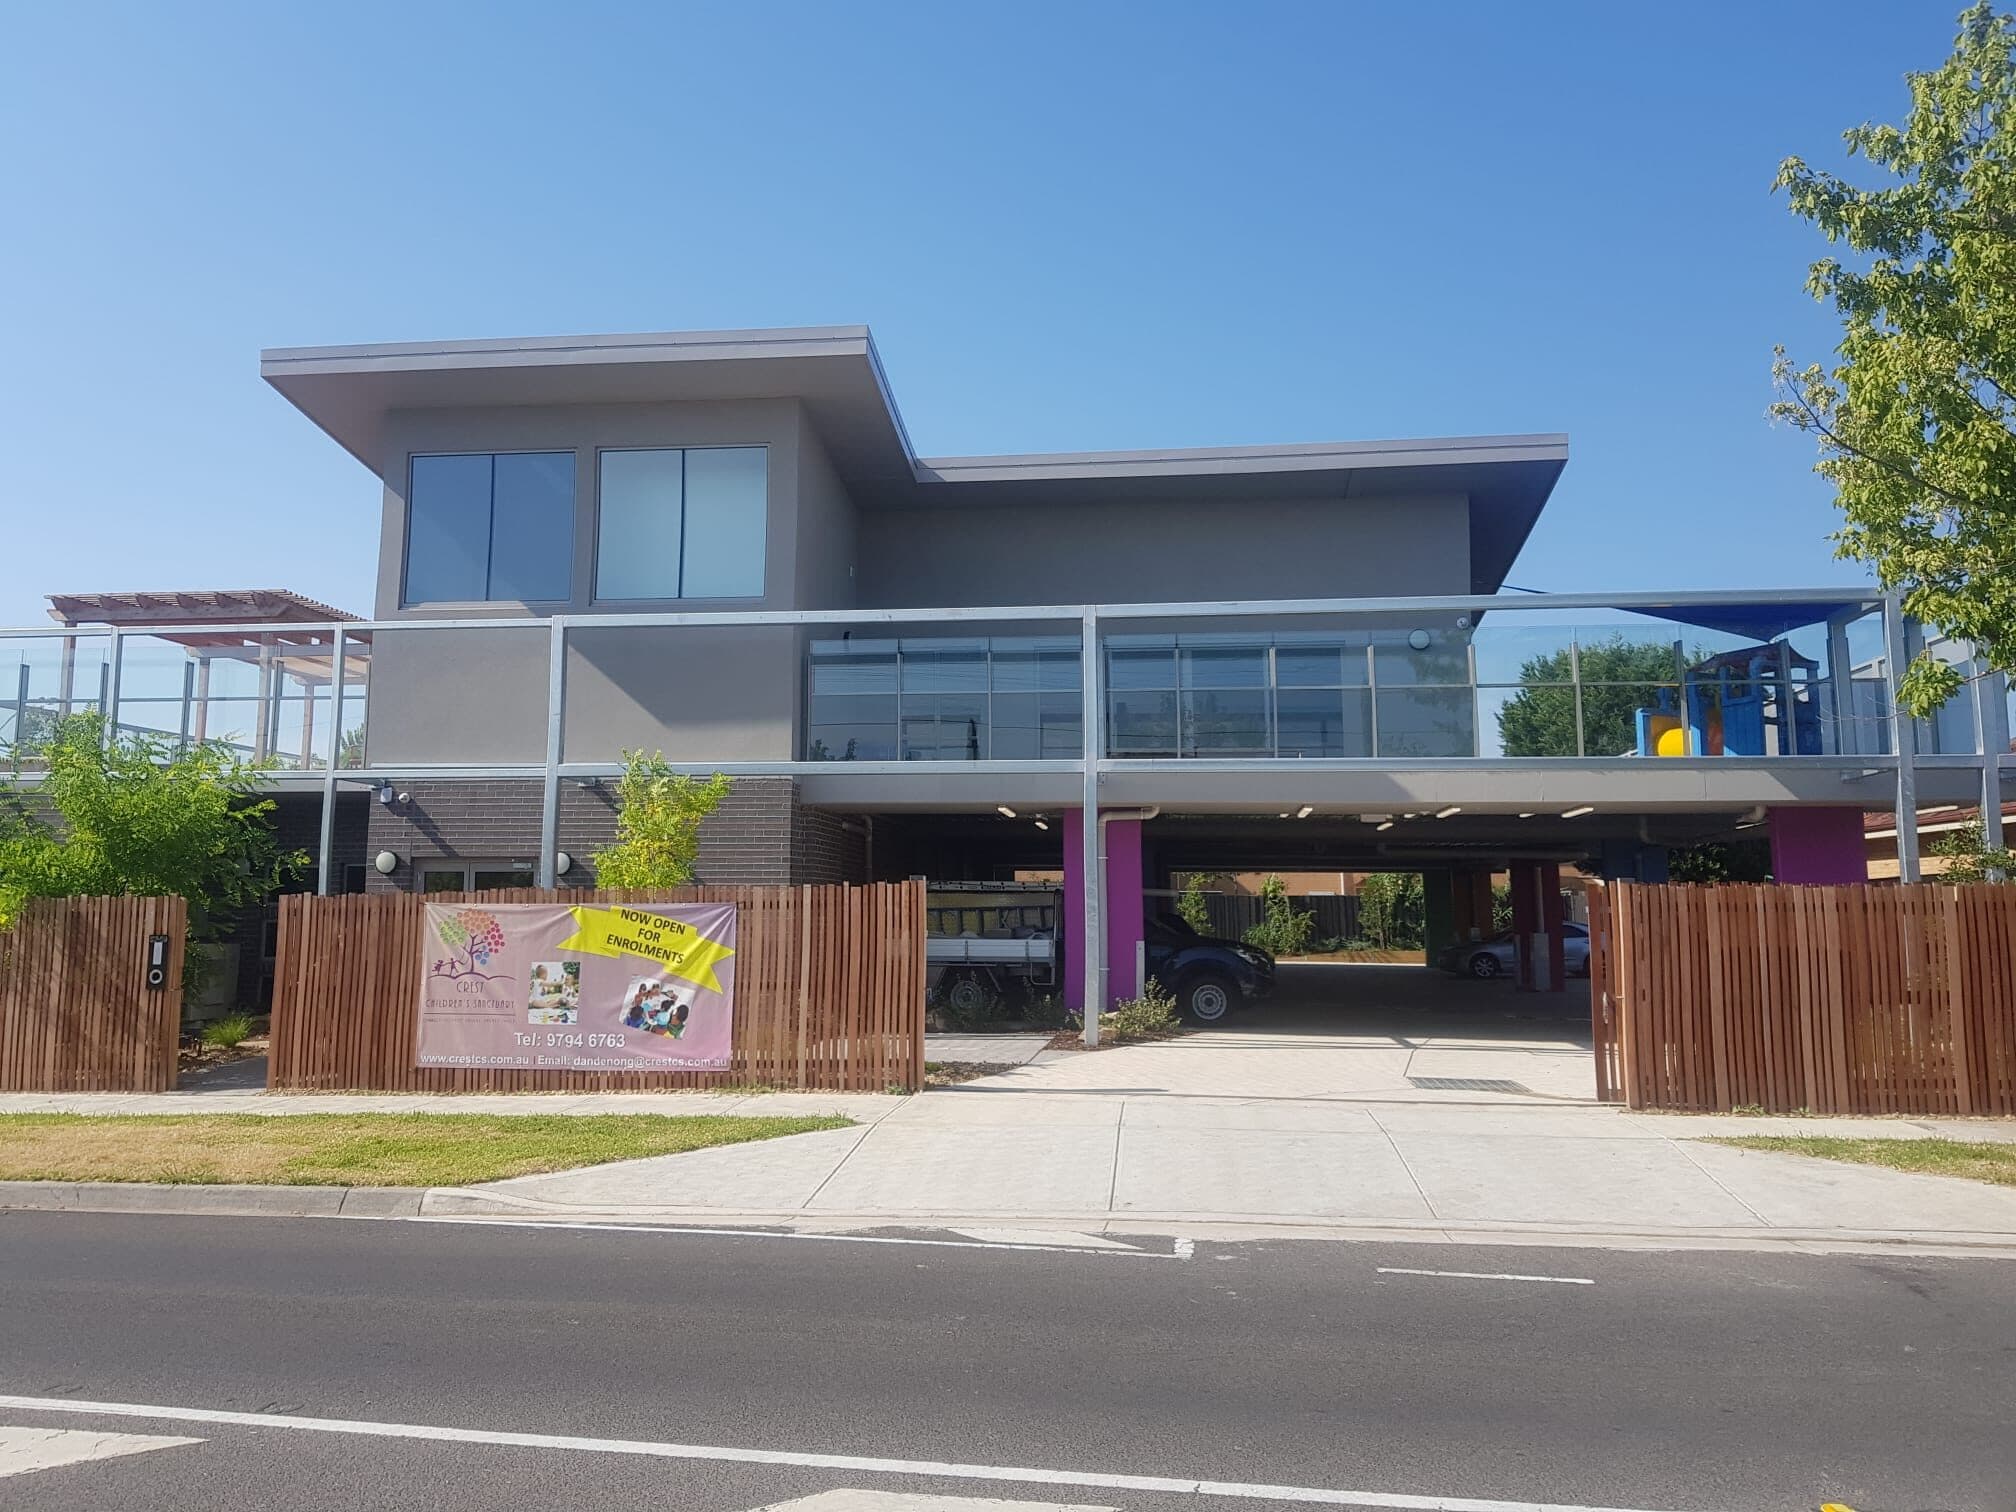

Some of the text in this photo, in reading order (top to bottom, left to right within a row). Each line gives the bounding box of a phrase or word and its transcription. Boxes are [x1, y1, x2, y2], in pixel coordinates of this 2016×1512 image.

[620, 908, 686, 935] NOW OPEN
[637, 927, 661, 943] FOR
[606, 933, 684, 964] ENROLMENTS
[456, 981, 486, 994] CREST
[514, 1032, 626, 1048] Tel: 9794 6763
[420, 1053, 727, 1069] www.crestcs.com.au Email: dandenong@crestcs.com.au
